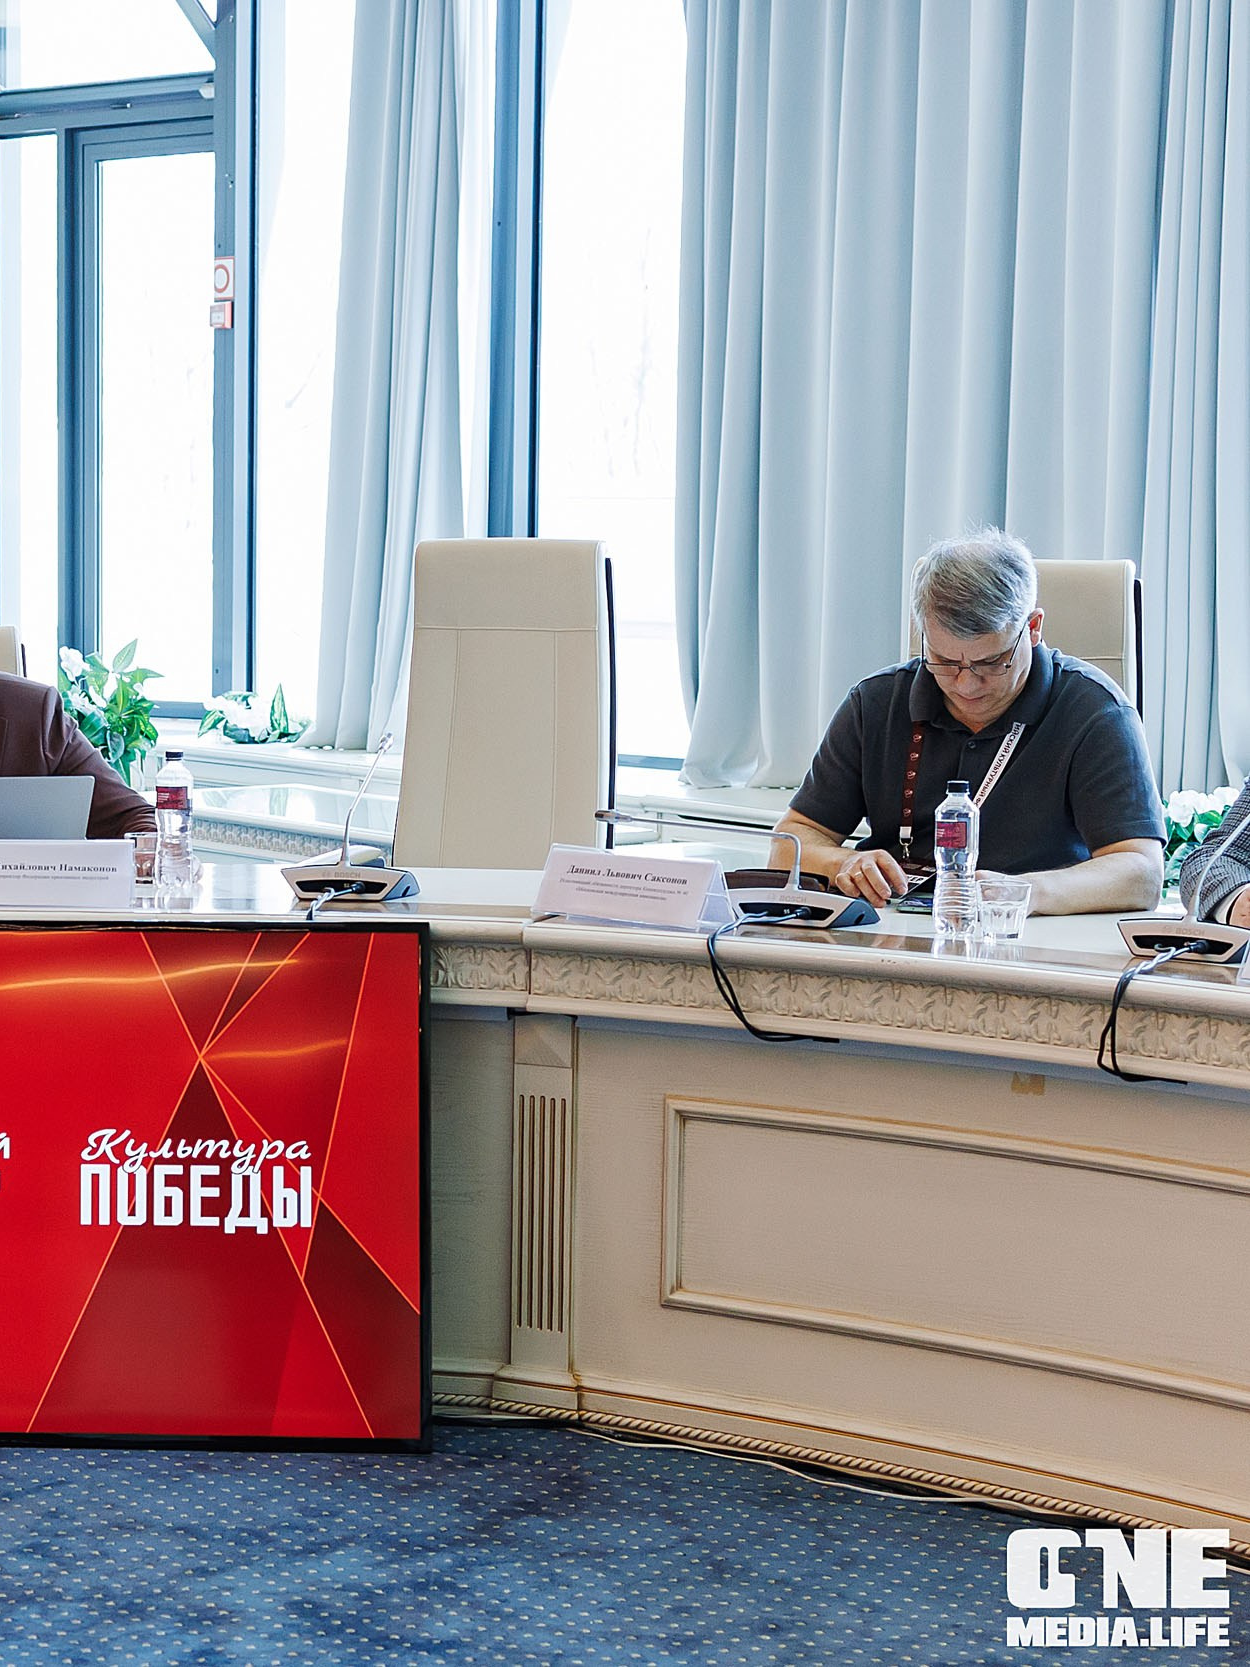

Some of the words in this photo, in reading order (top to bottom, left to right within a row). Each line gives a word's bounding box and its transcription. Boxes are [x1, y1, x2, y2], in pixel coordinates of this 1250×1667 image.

[979, 753, 1007, 797] КУЛЬТУРНЫЙ
[567, 864, 601, 876] Даниил
[602, 868, 642, 880] Львович
[644, 872, 688, 885] Саксонов
[81, 1129, 312, 1174] Культура
[80, 1164, 312, 1234] ПОБЕДЫ
